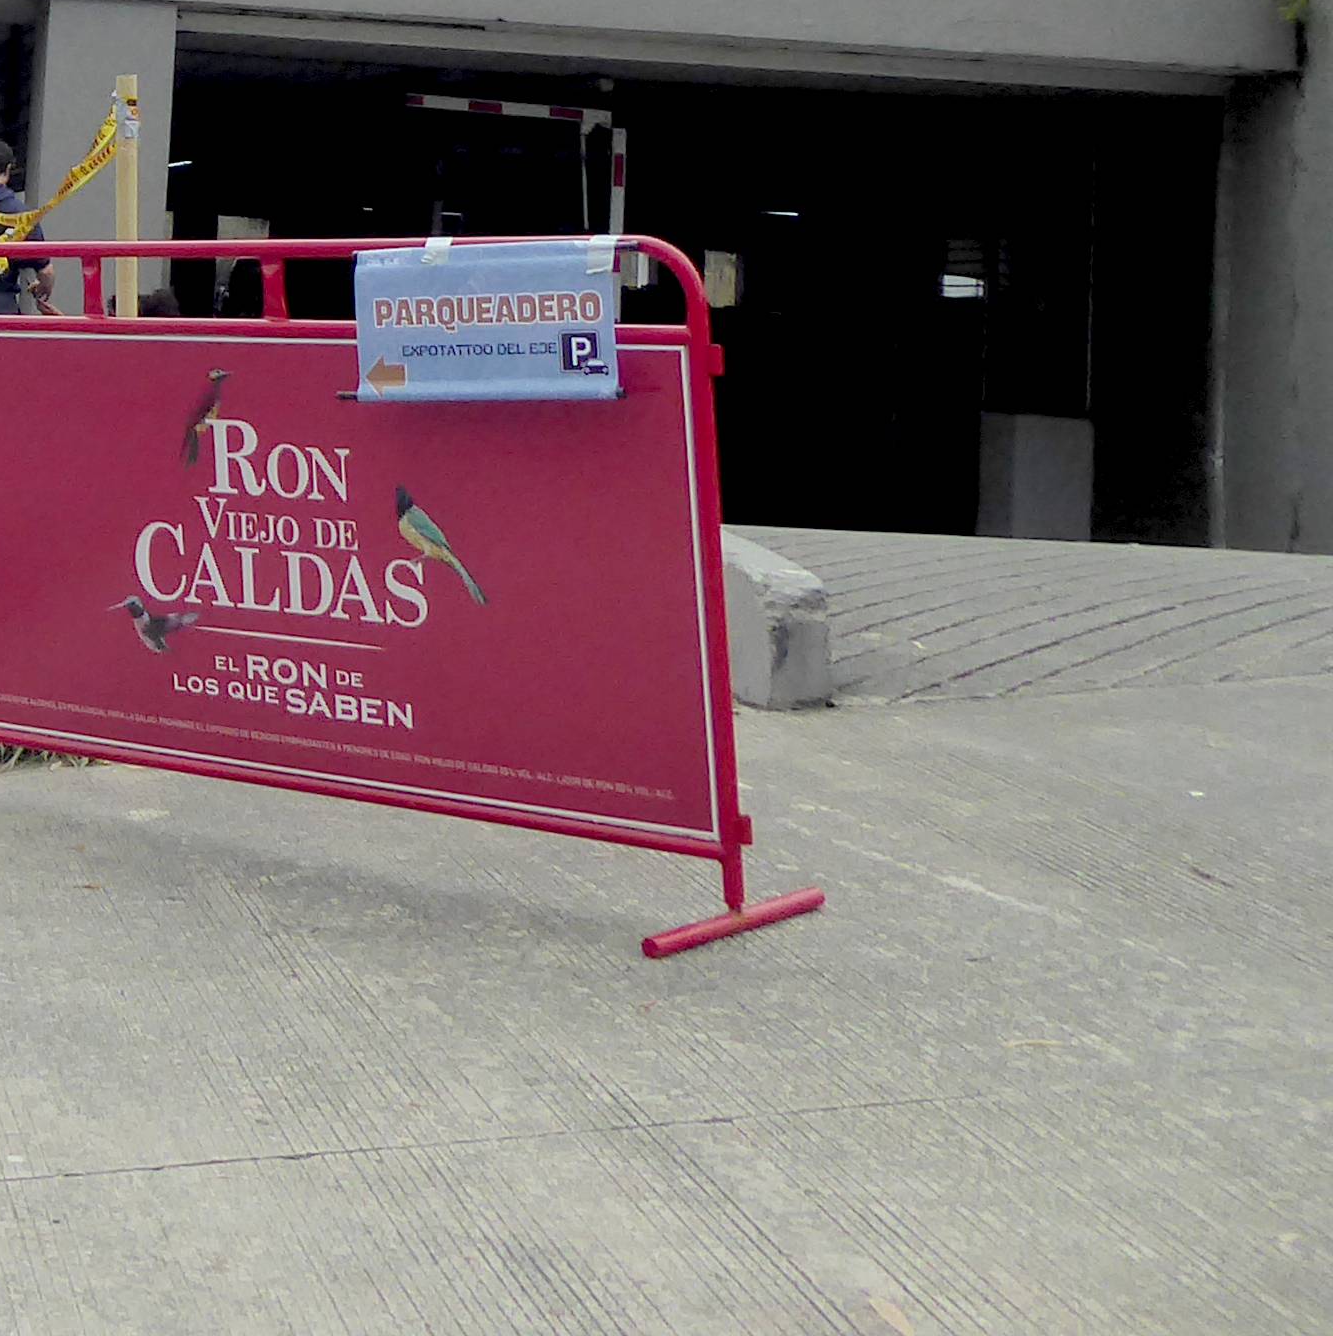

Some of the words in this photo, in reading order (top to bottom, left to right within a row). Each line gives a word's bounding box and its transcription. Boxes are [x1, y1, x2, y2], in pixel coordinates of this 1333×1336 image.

[373, 290, 603, 334] PARQUEADERO
[402, 344, 493, 357] EXPOTATTOO
[497, 343, 525, 355] DEL
[571, 337, 591, 366] P
[205, 418, 350, 502] RON
[194, 496, 299, 546] VIEJO
[313, 519, 359, 551] DE
[135, 521, 429, 628] CALDAS
[215, 656, 239, 672] EL
[246, 654, 328, 689] RON
[336, 669, 364, 688] DE
[173, 673, 220, 695] LOS
[228, 681, 279, 706] QUE
[285, 688, 414, 729] SABEN
